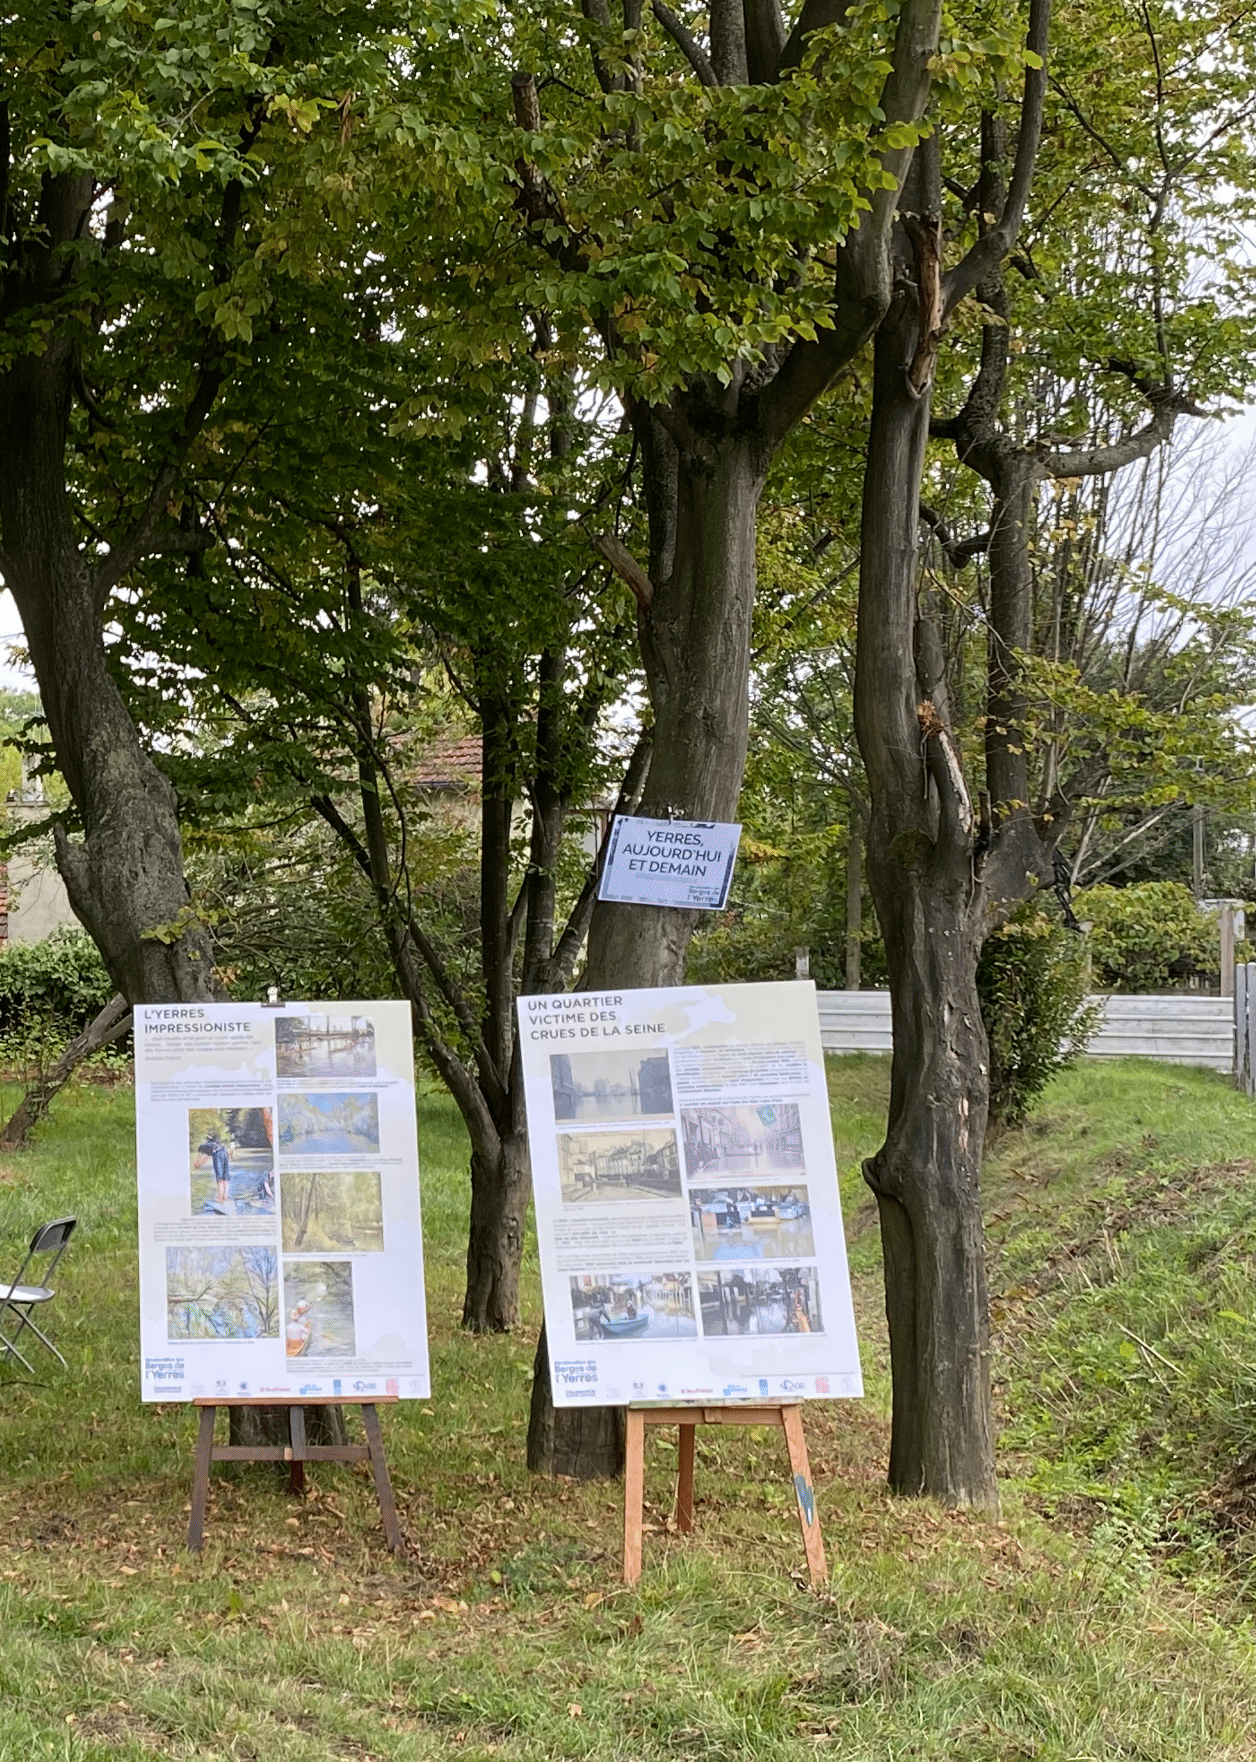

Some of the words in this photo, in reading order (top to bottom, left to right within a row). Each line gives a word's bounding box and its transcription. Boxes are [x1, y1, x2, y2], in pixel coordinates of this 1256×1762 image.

[647, 830, 704, 848] YERRES,
[621, 843, 722, 863] AUJOURD'HUI
[628, 859, 647, 872] ET
[648, 861, 707, 877] DEMAIN
[527, 1000, 548, 1011] UN
[551, 996, 623, 1009] QUARTIER
[144, 1008, 205, 1020] L'YERRES
[529, 1013, 585, 1026] VICTIME
[589, 1011, 617, 1022] DES
[144, 1022, 251, 1034] IMPRESSIONISTE
[530, 1028, 576, 1041] CRUES
[580, 1027, 599, 1038] DE
[603, 1026, 621, 1036] LA
[624, 1023, 666, 1035] SEINE
